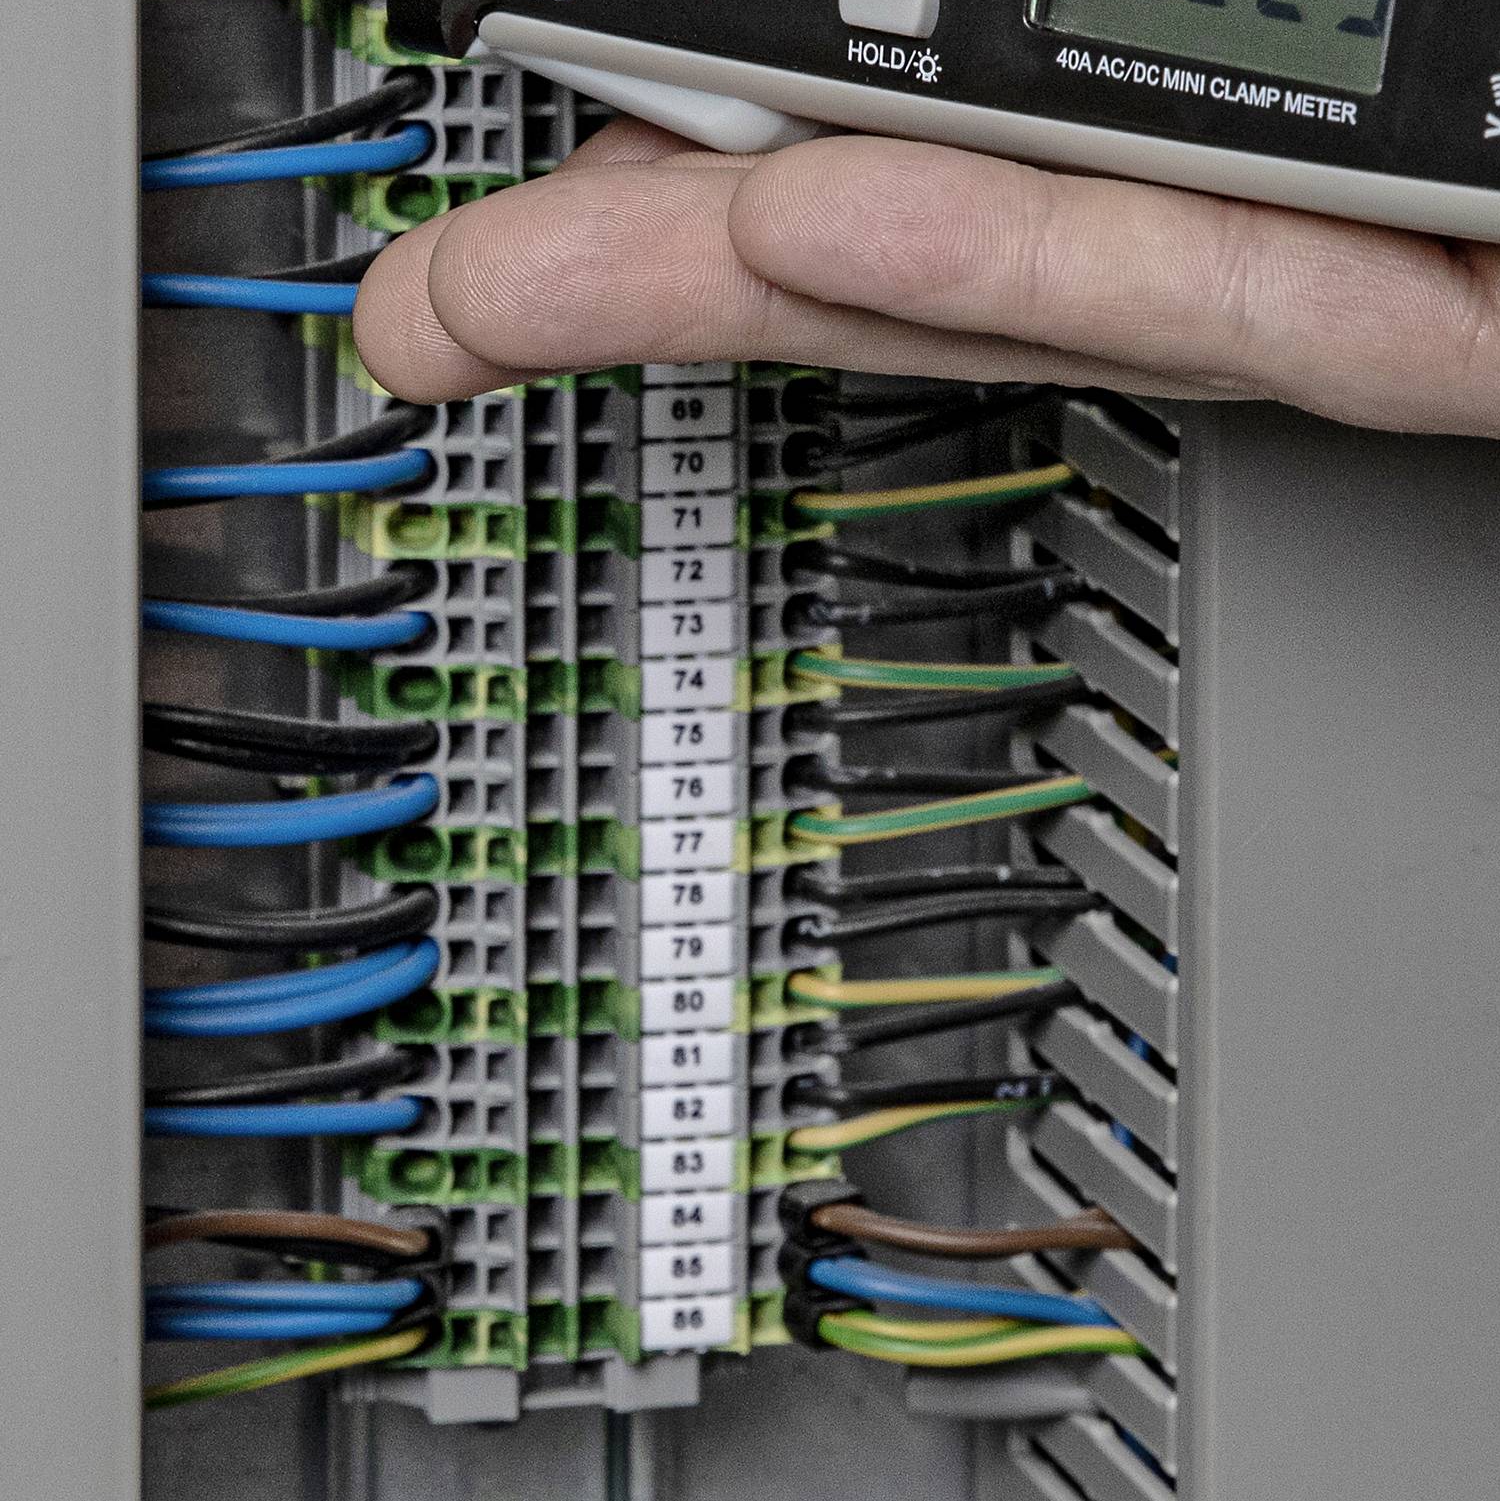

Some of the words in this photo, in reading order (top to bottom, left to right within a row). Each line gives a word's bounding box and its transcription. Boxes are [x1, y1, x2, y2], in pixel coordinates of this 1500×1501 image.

[1056, 47, 1092, 74] 40A
[1096, 56, 1159, 87] AC/DC
[1162, 67, 1205, 95] MINI
[1209, 76, 1280, 109] CLAMP
[1283, 90, 1358, 125] METER
[672, 450, 705, 474] 70
[673, 506, 702, 529] 71
[672, 559, 704, 582] 72
[672, 613, 704, 636] 73
[674, 669, 704, 691] 74
[673, 722, 704, 745] 75
[673, 776, 704, 799] 76
[673, 830, 704, 853] 77
[673, 883, 704, 905] 78
[672, 936, 704, 959] 79
[672, 1045, 701, 1067] 81
[673, 1098, 704, 1121] 82
